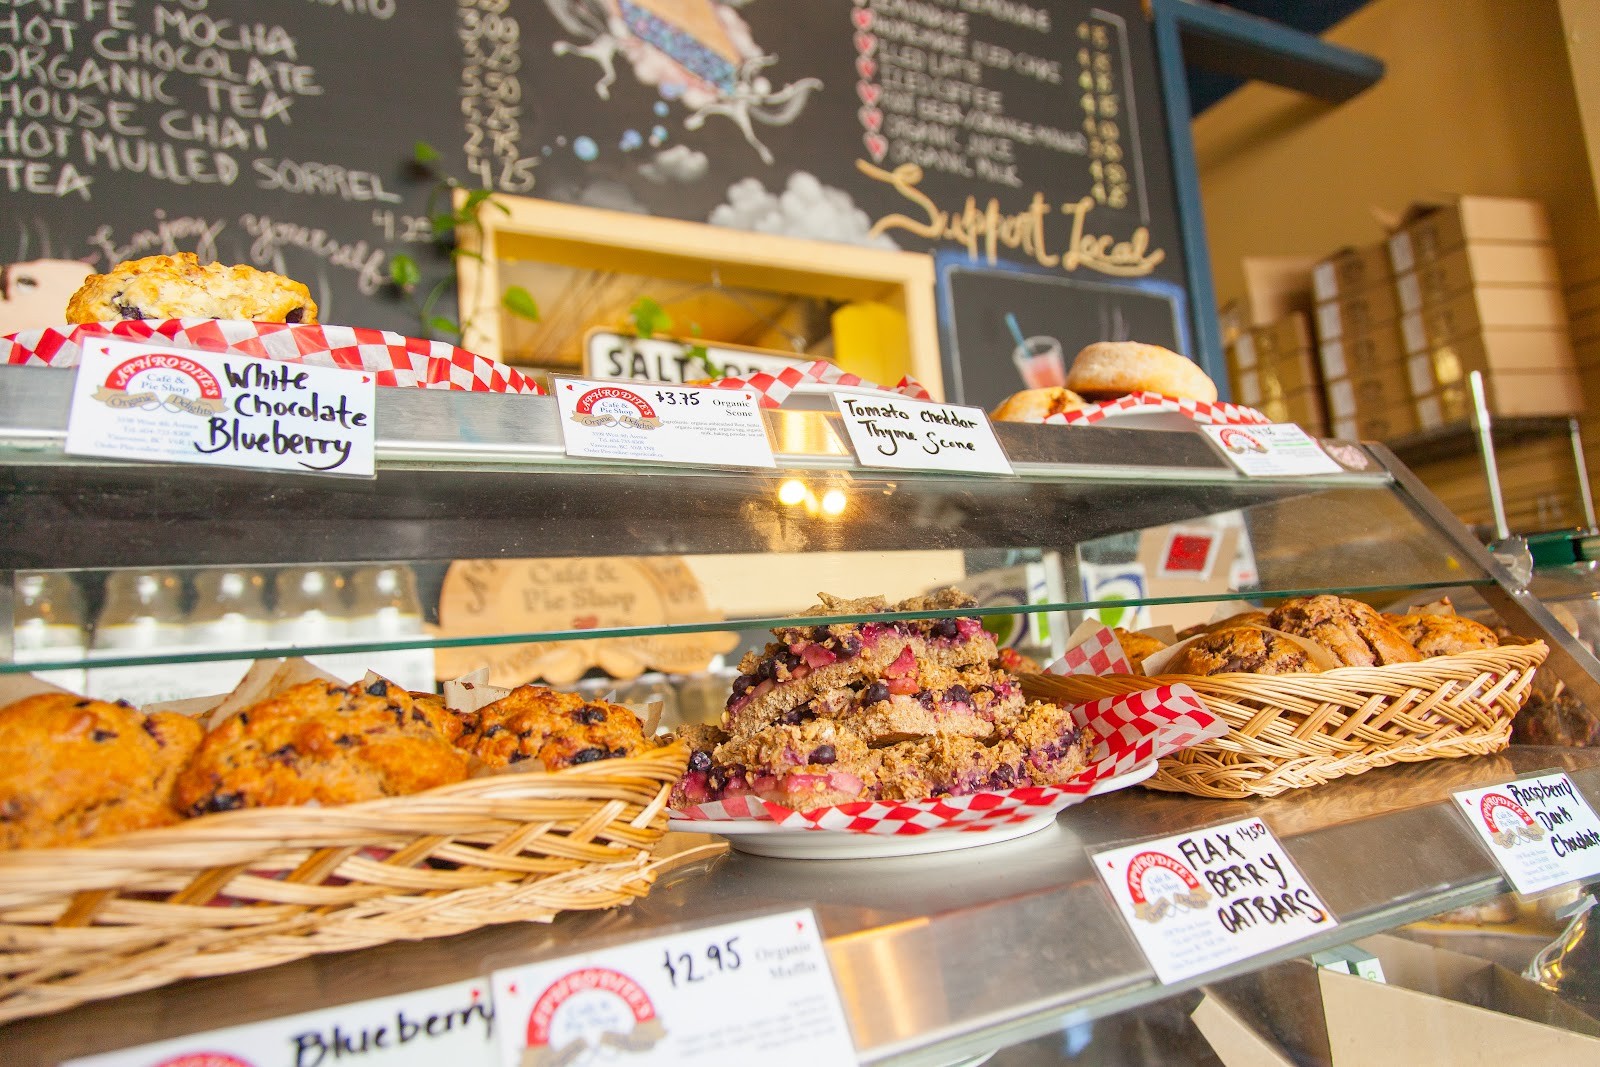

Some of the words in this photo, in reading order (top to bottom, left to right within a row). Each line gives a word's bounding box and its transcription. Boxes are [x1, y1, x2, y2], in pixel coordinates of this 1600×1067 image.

[0, 9, 79, 51] HOT
[92, 28, 325, 96] CHOCOLATE
[153, 4, 298, 60] MOCHA
[0, 43, 181, 106] ORGANIC
[198, 78, 293, 126] TEA
[0, 82, 148, 136] HOUSE
[159, 108, 268, 150] CHAI
[0, 117, 73, 158] HOT
[81, 127, 239, 187] MULLED
[253, 157, 401, 203] SORREL
[0, 157, 93, 201] TEA
[854, 157, 1060, 267] Support
[1060, 196, 1166, 277] Local
[223, 362, 309, 392] White
[712, 398, 751, 410] Organic
[726, 409, 753, 418] Scone
[843, 399, 910, 420] Tomato
[194, 417, 352, 471] Blueberry
[857, 419, 917, 457] Thyme
[922, 431, 976, 455] Scone
[1535, 805, 1573, 832] Dark
[1178, 834, 1246, 872] FLAX
[1204, 853, 1289, 898] BERRY
[660, 936, 742, 988] $2.95
[293, 1000, 493, 1067] Blueberry
